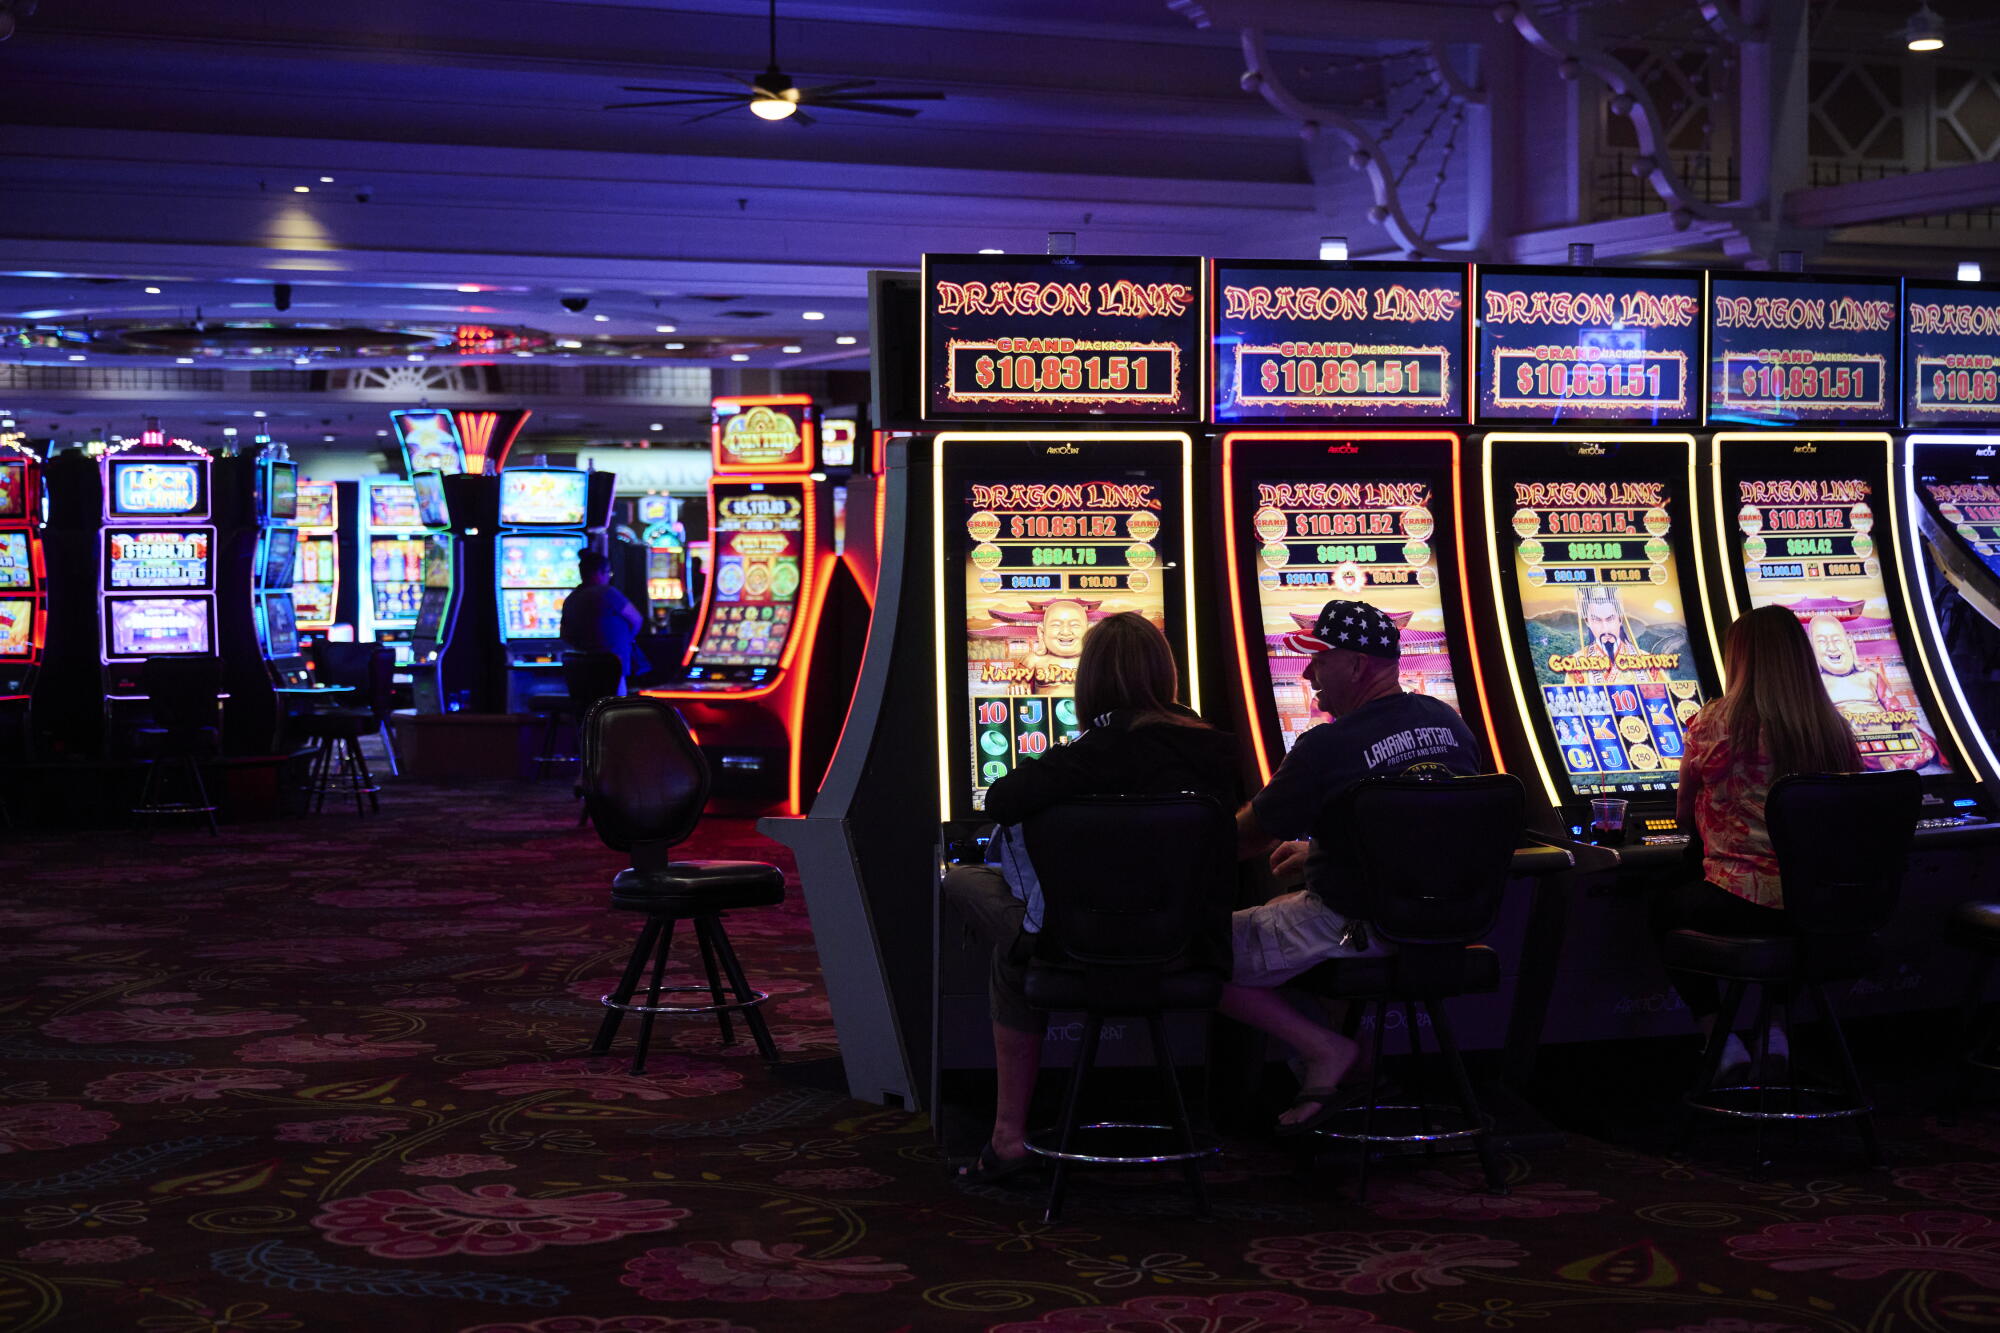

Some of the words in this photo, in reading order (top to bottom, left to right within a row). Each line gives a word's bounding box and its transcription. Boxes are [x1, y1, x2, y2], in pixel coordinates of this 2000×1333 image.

[937, 281, 1091, 316] DRAGON
[1224, 285, 1368, 320] DRAGON
[1485, 290, 1615, 325] DRAGON
[1716, 296, 1825, 330] DRAGON
[996, 337, 1076, 353] GRAND
[1077, 341, 1132, 351] JACKPOT
[1280, 342, 1353, 358] GRAND
[1354, 345, 1405, 355] JACKPOT
[1535, 345, 1601, 361] GRAND
[1602, 349, 1648, 359] JACKPOT
[1758, 349, 1814, 364] GRAND
[1945, 354, 1993, 369] GRAND
[976, 356, 1148, 392] $10,831.51
[1261, 360, 1420, 395] $10,831.51
[1517, 363, 1661, 398] $10,831.51
[1743, 366, 1864, 399] $10,831.51
[1933, 370, 2000, 403] $10,83
[972, 484, 1082, 508] DRAGON
[1258, 483, 1361, 507] DRAGON
[1514, 482, 1607, 506] DRAGON
[1739, 480, 1818, 503] DRAGON
[1011, 515, 1116, 538] $10,831.52
[1126, 520, 1160, 528] GRAND
[1296, 513, 1393, 536] $10,831.52
[1769, 509, 1843, 530] $10,831.52
[982, 663, 1035, 682] HAPPY
[1549, 654, 1611, 672] GOLDEN
[1615, 653, 1680, 671] CENTURY
[979, 701, 1007, 724] 10
[1020, 700, 1042, 724] J
[1611, 690, 1638, 712] 10
[1646, 703, 1674, 726] K
[1588, 717, 1617, 740] K
[1626, 725, 1641, 734] 150
[1018, 731, 1047, 754] 10
[1364, 730, 1416, 769] LAHAINA
[1414, 727, 1459, 748] PATROL
[1659, 731, 1681, 754] J
[1387, 750, 1416, 767] PROTECT
[1417, 747, 1430, 757] AND
[1430, 745, 1448, 755] SERVE
[1567, 748, 1594, 769] Q
[1601, 746, 1623, 768] J
[1636, 753, 1652, 762] 150
